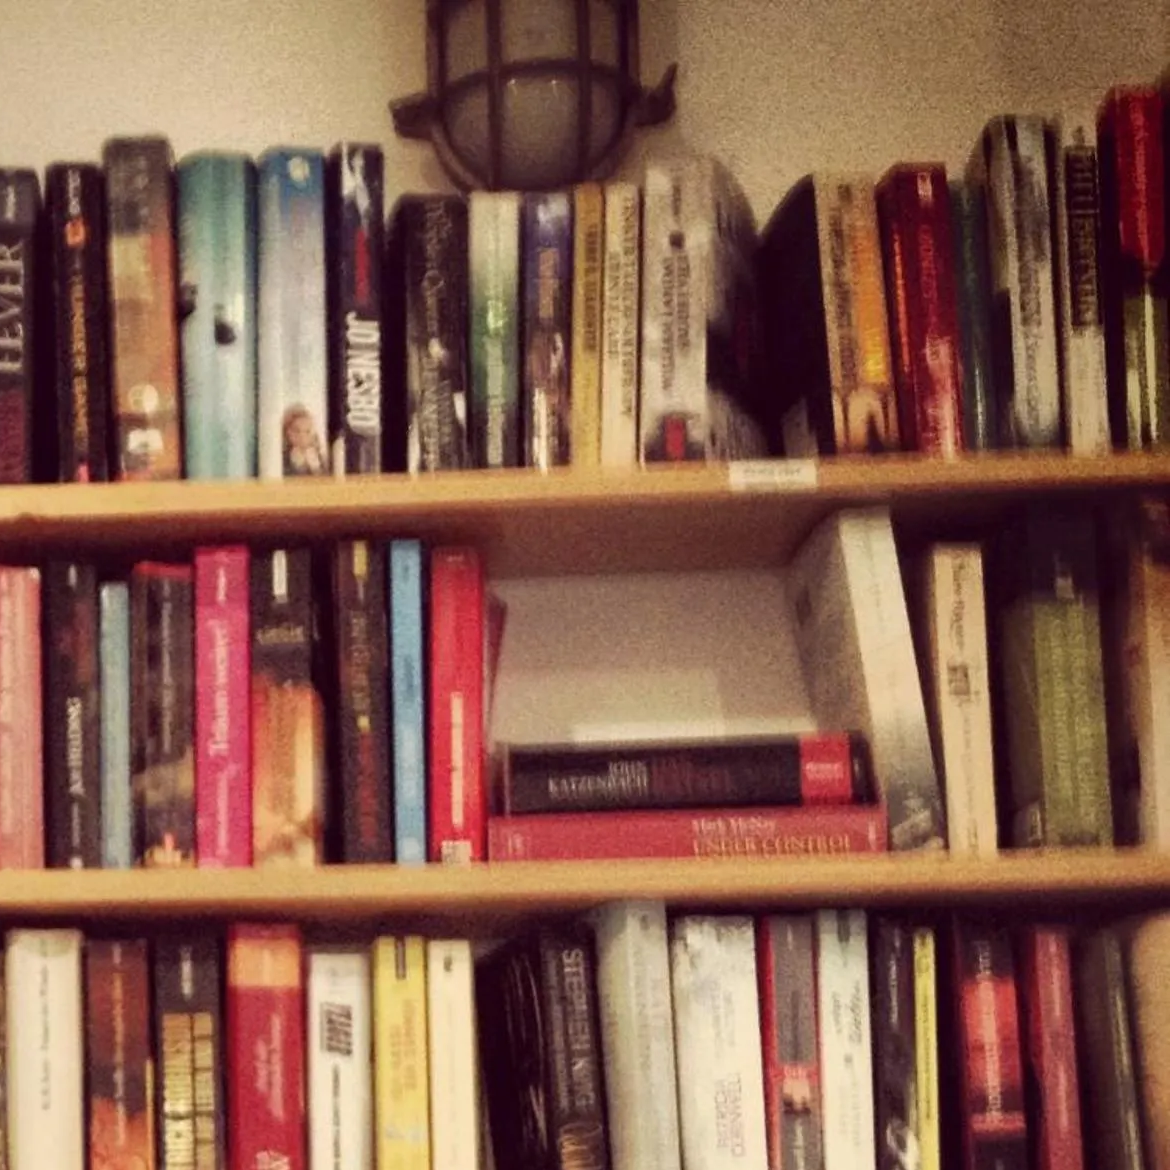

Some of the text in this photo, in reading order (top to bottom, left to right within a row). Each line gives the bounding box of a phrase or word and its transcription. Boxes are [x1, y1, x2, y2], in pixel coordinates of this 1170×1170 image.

[345, 312, 381, 347] JO
[561, 948, 595, 1108] STEPHEN KING
